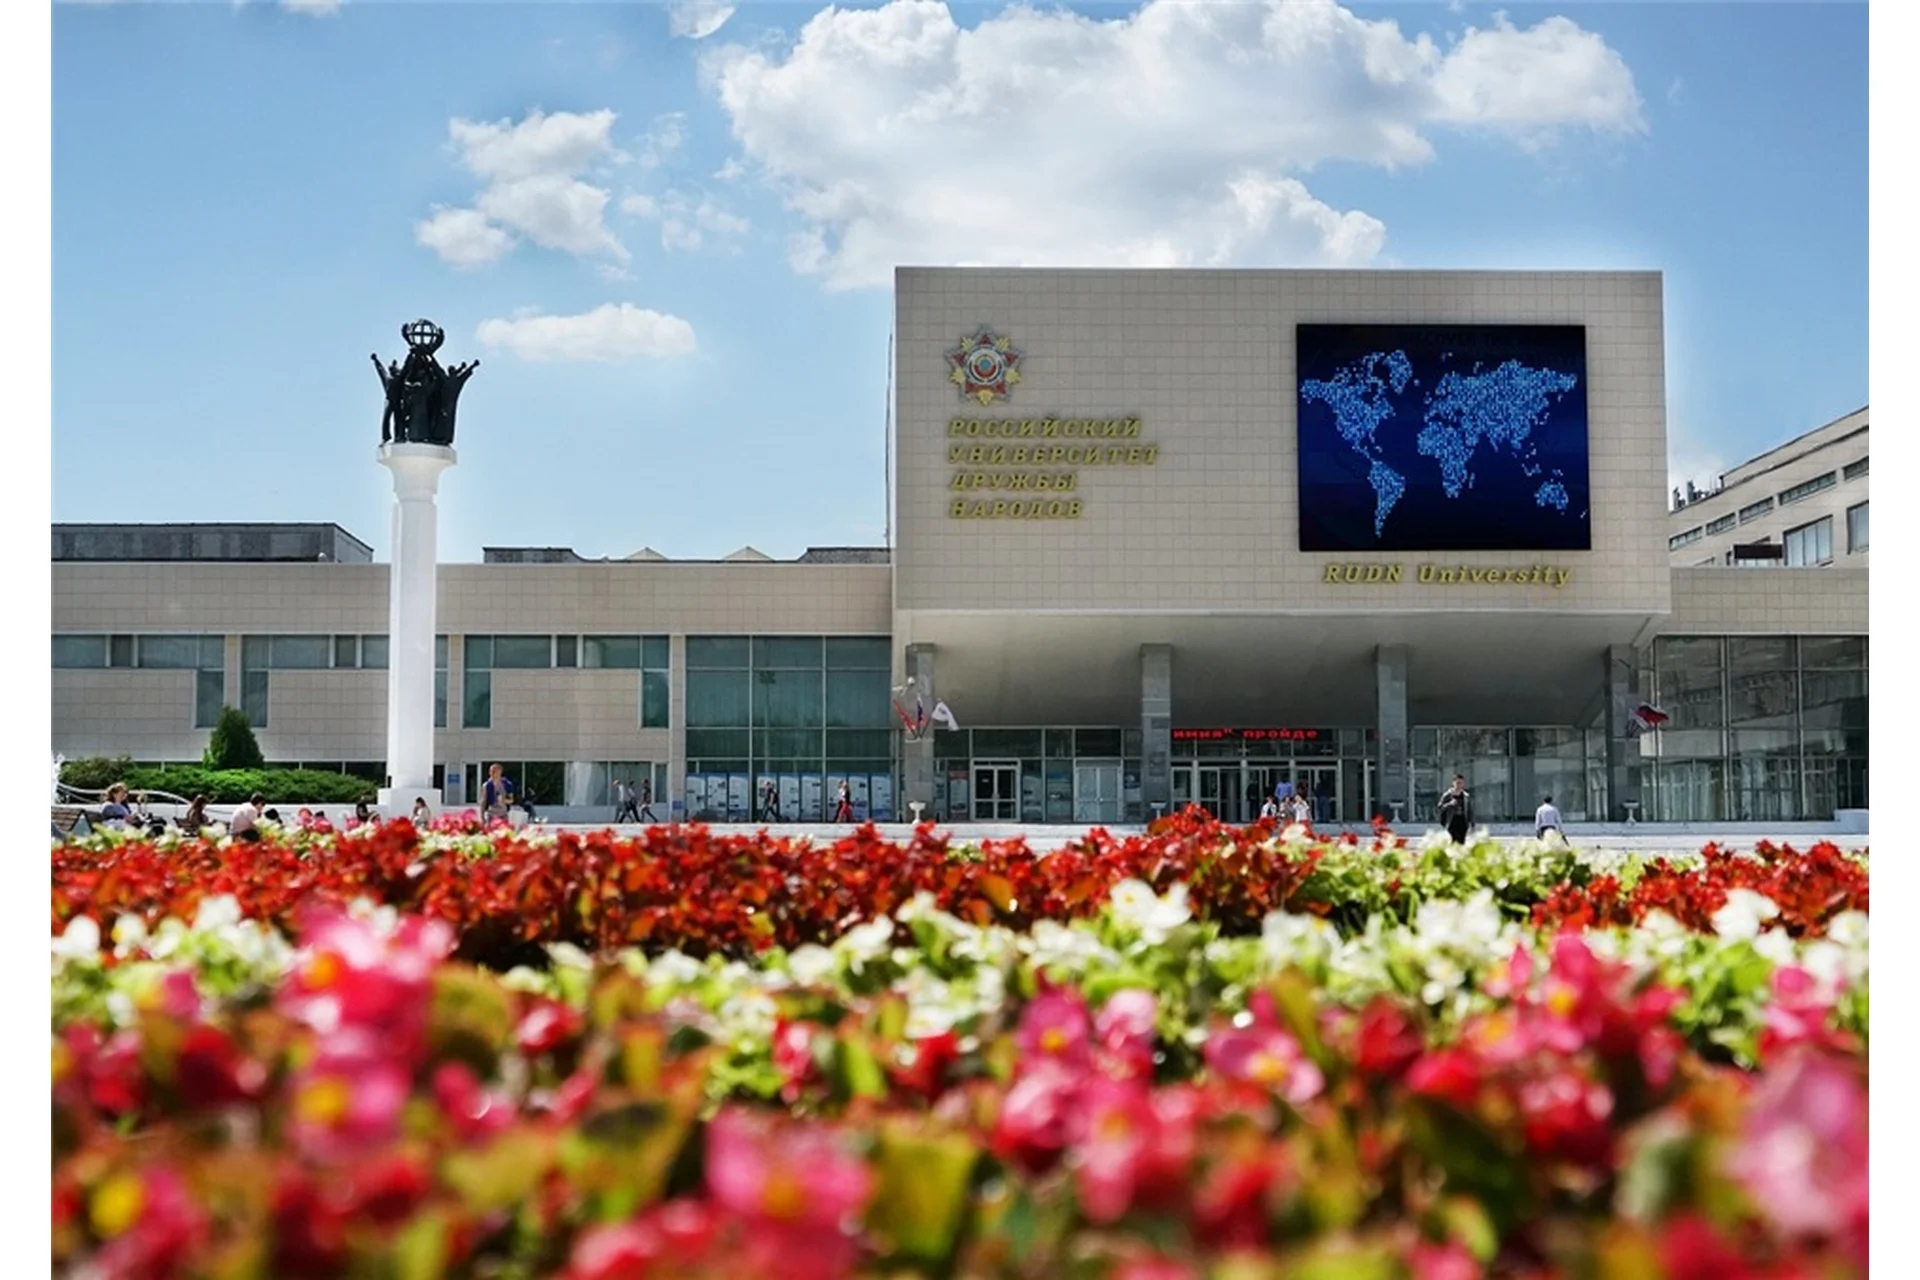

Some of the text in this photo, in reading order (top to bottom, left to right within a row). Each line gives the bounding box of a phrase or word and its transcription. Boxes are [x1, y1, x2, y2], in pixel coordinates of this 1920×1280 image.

[949, 414, 1142, 438] РОССИЙСКИЙ
[949, 444, 1160, 465] УНИВЕРСИТЕТ
[950, 473, 1077, 491] ДРУЖБЫ
[950, 499, 1084, 519] НАРОДОВ
[1324, 564, 1573, 587] RUDN University
